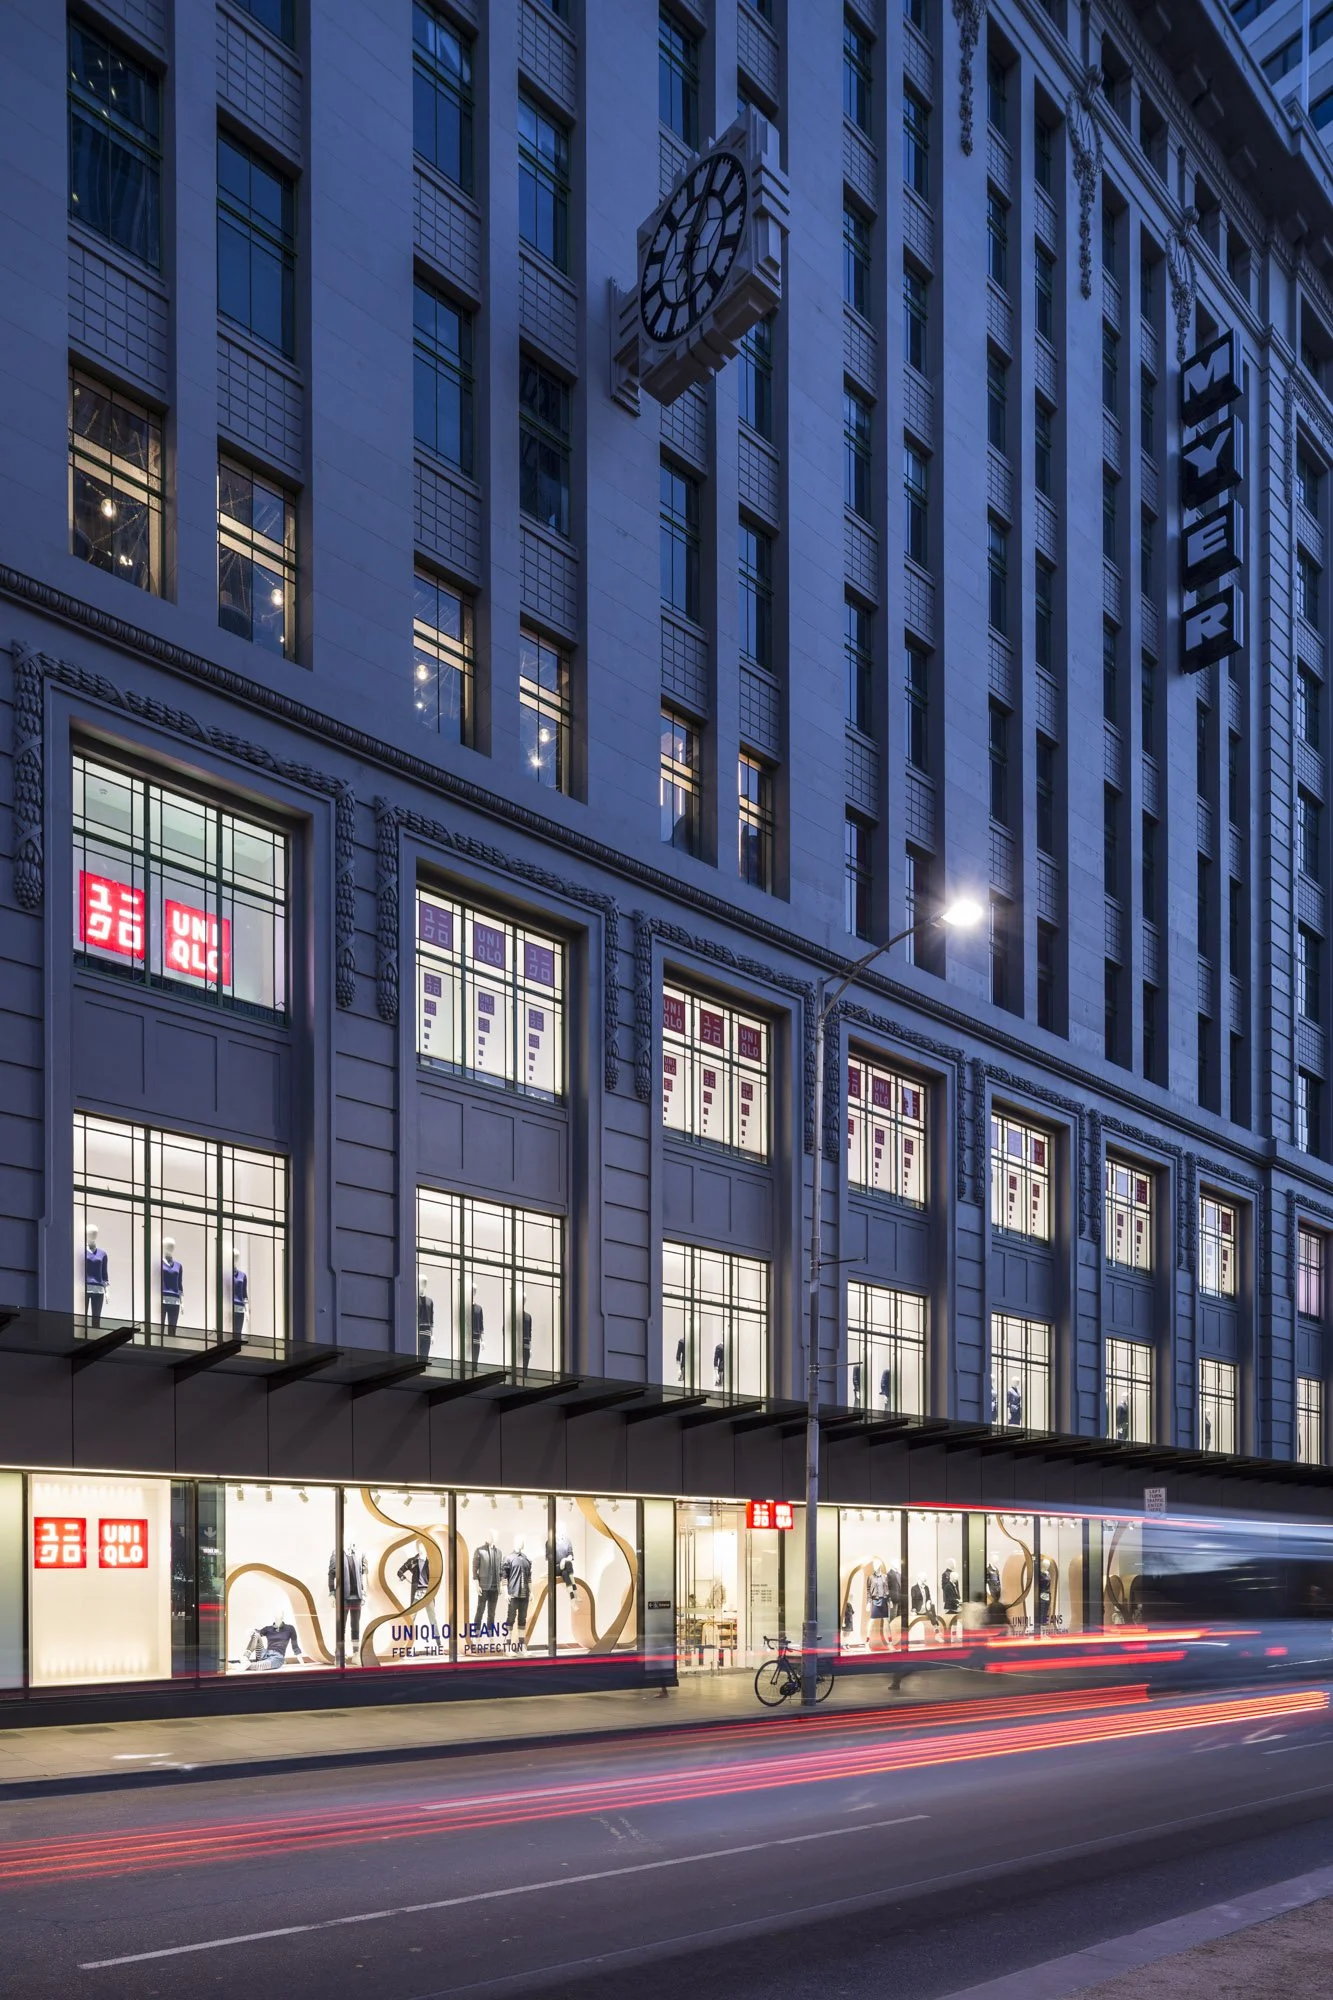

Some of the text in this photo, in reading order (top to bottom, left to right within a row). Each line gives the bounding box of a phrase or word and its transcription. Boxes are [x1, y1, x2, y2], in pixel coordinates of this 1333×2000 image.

[1183, 342, 1231, 651] MYER
[90, 883, 141, 921] ユニ
[87, 914, 142, 950] クロ
[172, 910, 218, 945] UNI
[478, 928, 500, 948] UNI
[478, 945, 502, 963] QLO
[663, 1000, 680, 1017] UNI
[663, 1014, 682, 1029] QLO
[741, 1029, 757, 1045] UNI
[742, 1043, 758, 1057] QLO
[41, 1523, 80, 1542] ユニ
[103, 1525, 140, 1542] UNI
[40, 1545, 81, 1563] クロ
[103, 1545, 143, 1566] QLO
[392, 1622, 509, 1642] UNIQLO JEANS
[392, 1643, 523, 1657] FEEL THE PERFECTION
